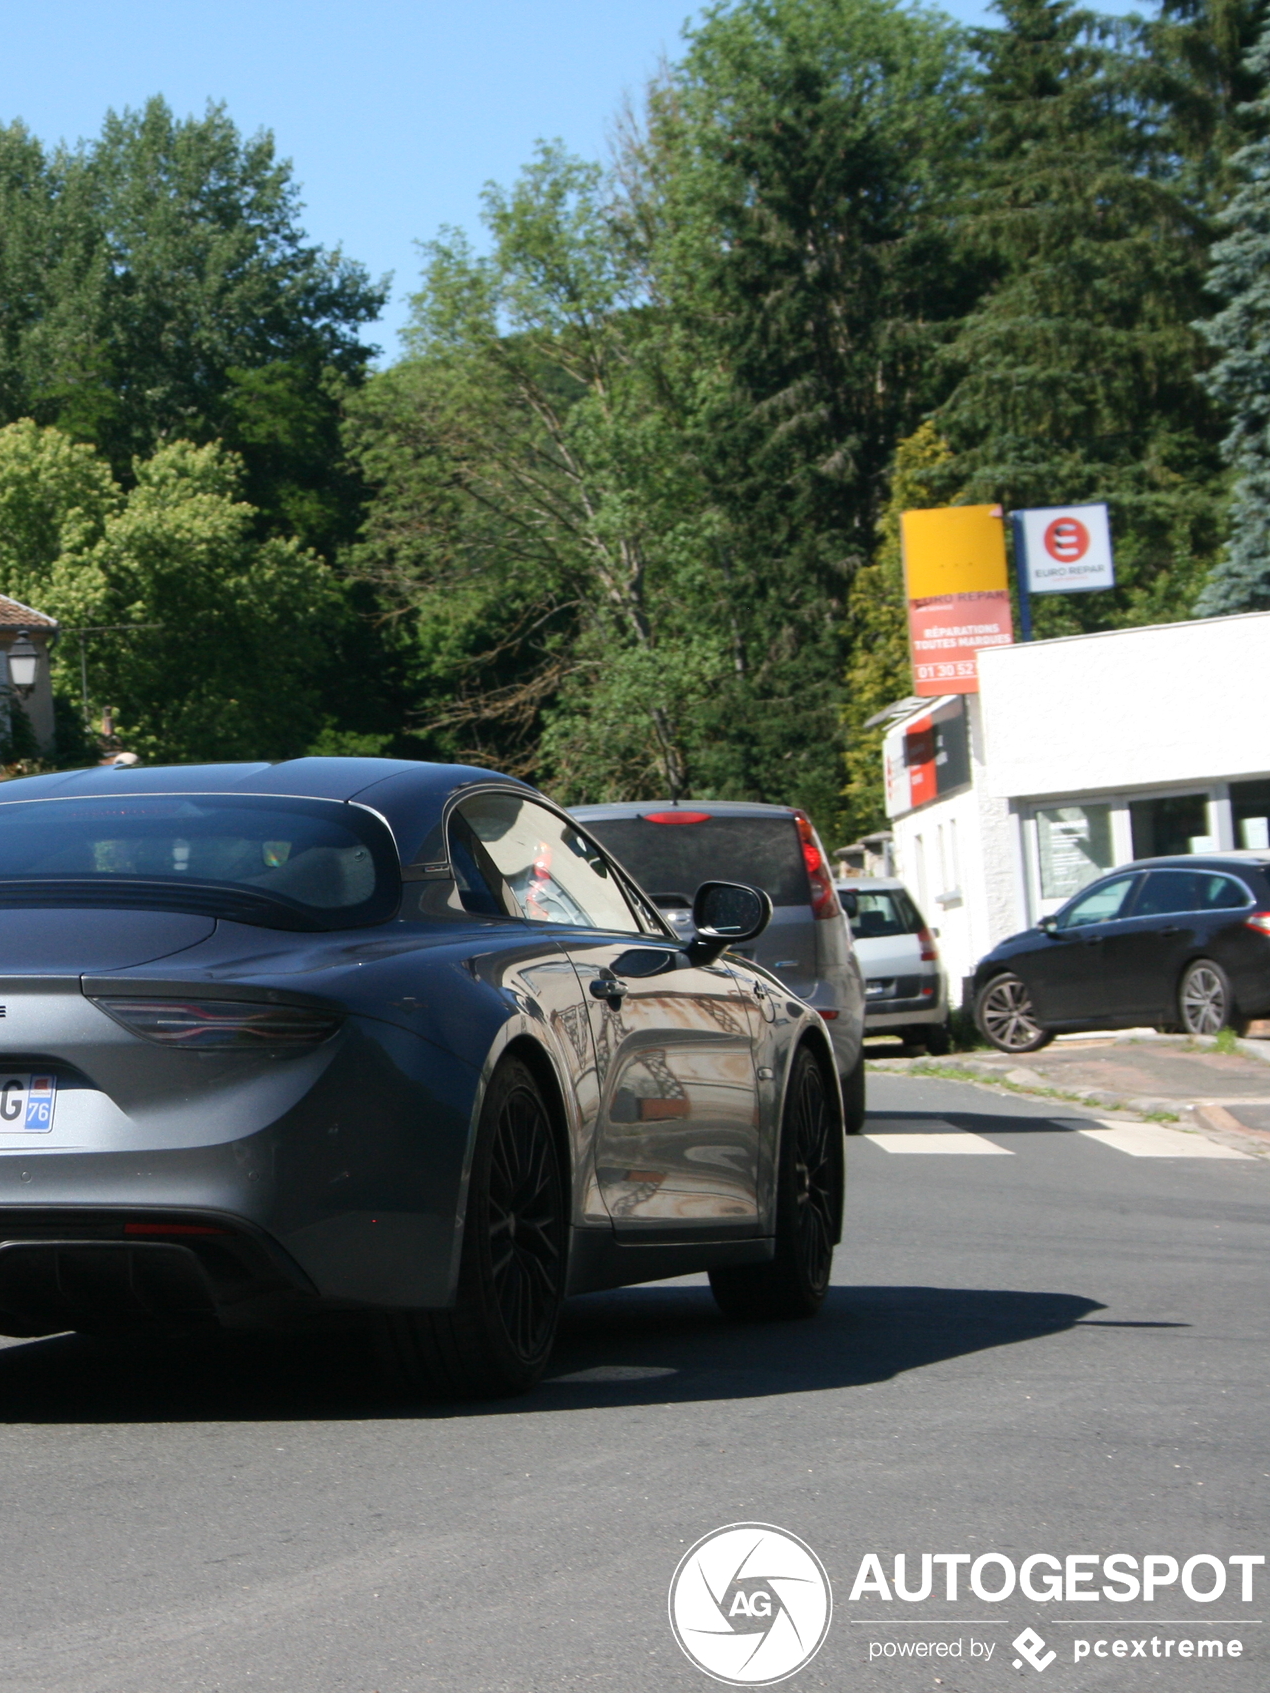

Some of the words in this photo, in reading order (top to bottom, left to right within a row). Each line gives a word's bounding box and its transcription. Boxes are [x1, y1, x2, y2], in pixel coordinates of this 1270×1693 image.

[1035, 567, 1066, 577] EURO
[1069, 564, 1105, 575] REPAR
[923, 623, 1000, 639] RÉPARATIONS
[914, 638, 957, 650] TOUTES
[957, 633, 1011, 647] MARQUES
[918, 666, 935, 679] 01
[937, 664, 955, 677] 30
[956, 663, 974, 675] 52
[27, 1102, 50, 1122] 76
